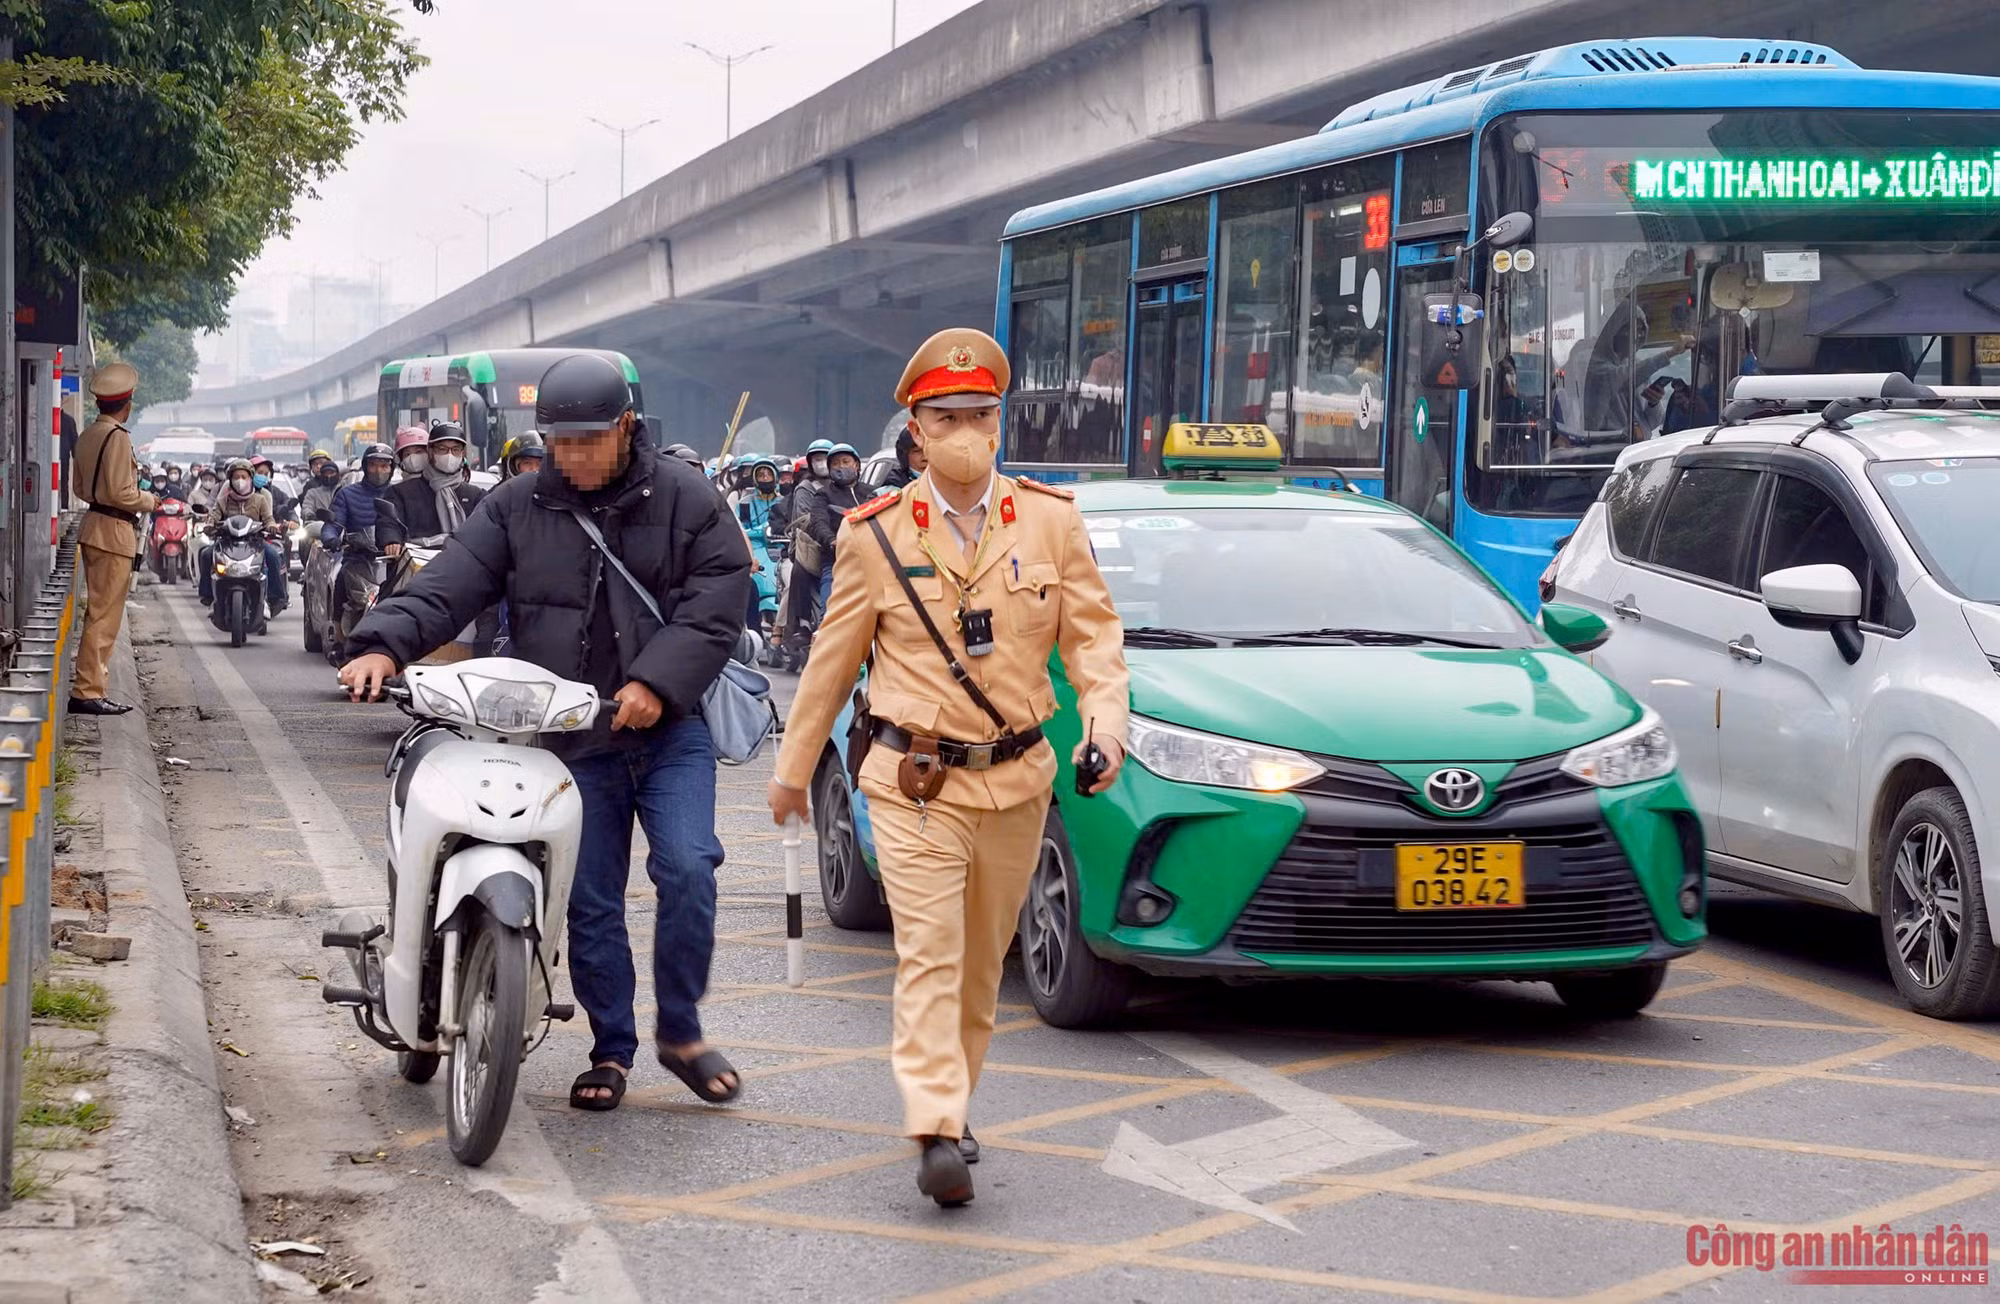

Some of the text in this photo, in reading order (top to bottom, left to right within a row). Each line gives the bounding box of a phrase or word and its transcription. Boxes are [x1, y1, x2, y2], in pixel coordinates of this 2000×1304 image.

[483, 758, 522, 768] HONDA
[1434, 847, 1487, 875] 29E
[1412, 877, 1511, 906] 038.42
